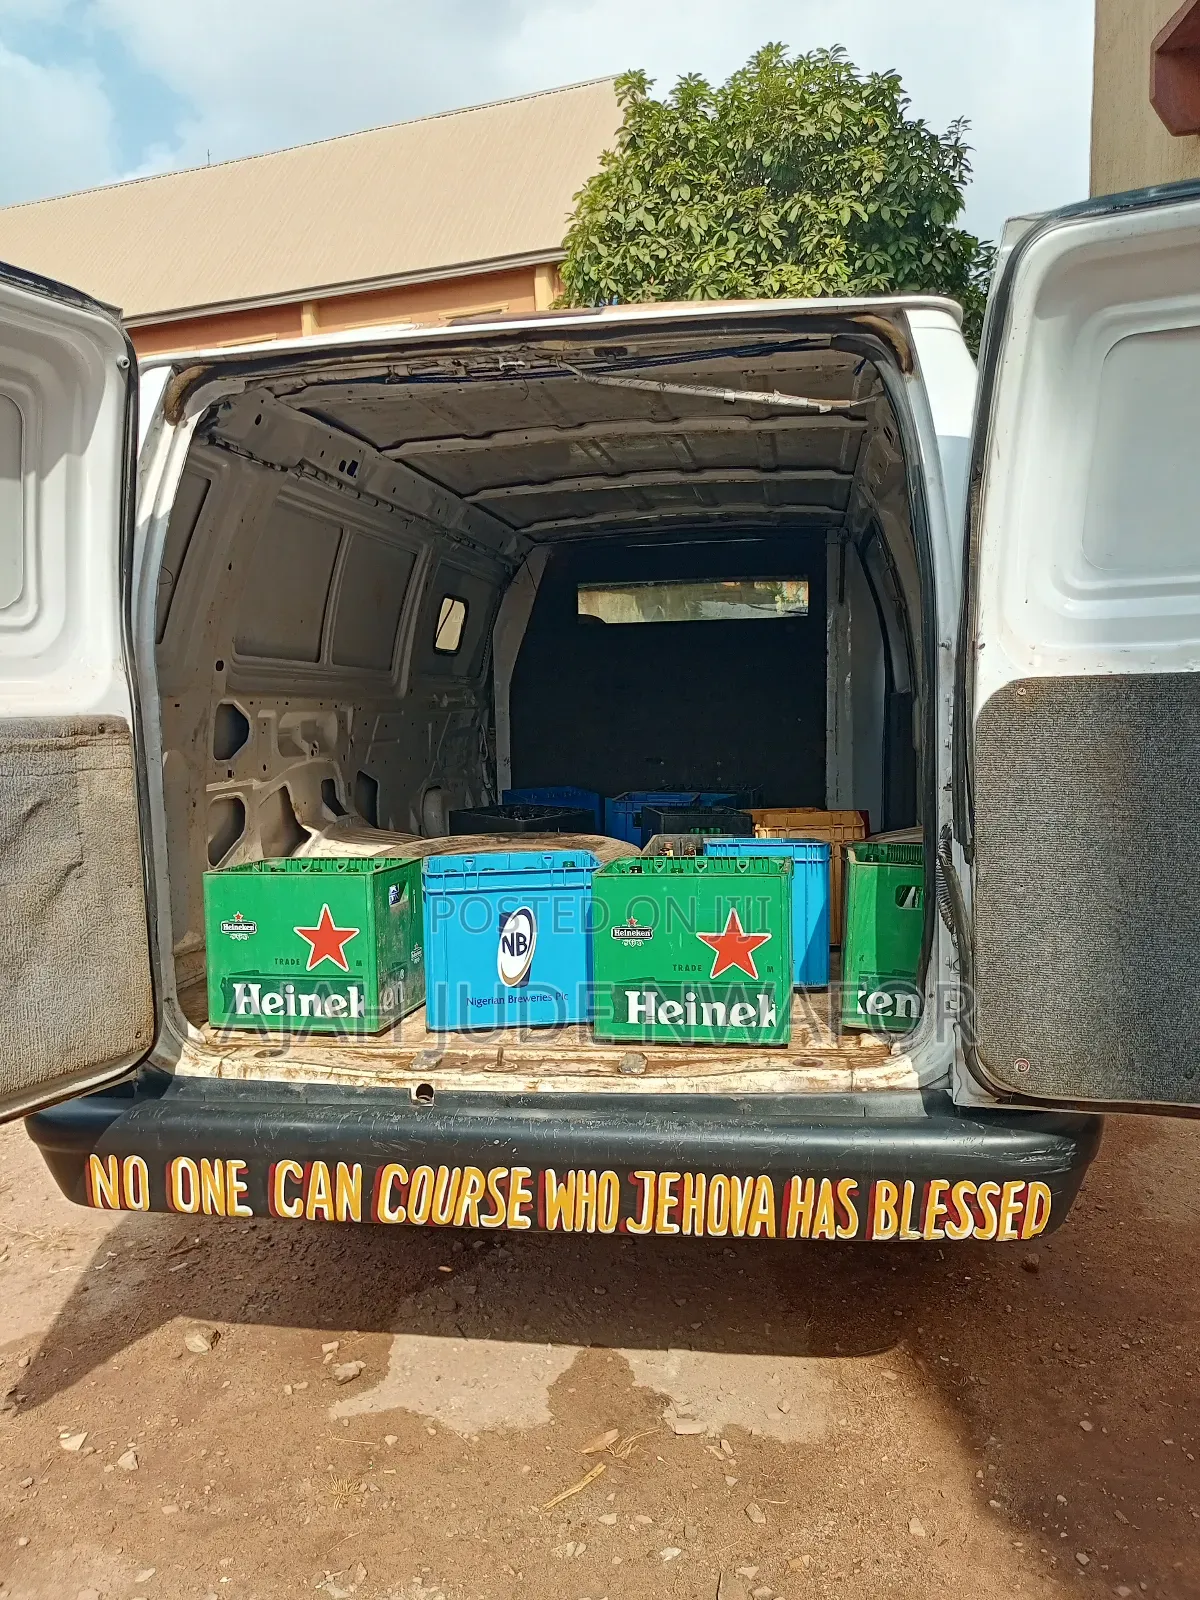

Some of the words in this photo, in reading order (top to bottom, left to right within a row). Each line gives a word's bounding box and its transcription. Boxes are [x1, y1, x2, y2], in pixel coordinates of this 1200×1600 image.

[222, 923, 255, 931] Heineken
[614, 929, 651, 937] Heineken
[501, 932, 528, 957] NB
[274, 957, 301, 966] TRADE
[673, 964, 703, 972] TRADE
[233, 983, 366, 1018] Heinek
[466, 997, 505, 1008] Nigerian
[508, 994, 552, 1004] Breweries
[556, 992, 569, 1001] Plc
[625, 990, 777, 1028] Heinek
[86, 1154, 149, 1211] NO
[166, 1156, 253, 1217] ONE
[270, 1159, 362, 1222] CAN
[375, 1163, 535, 1229] COURSE
[541, 1168, 620, 1234] WHO
[622, 1169, 776, 1238] JEHOVA
[781, 1174, 860, 1240] HAS
[866, 1178, 1052, 1242] BLESSED
